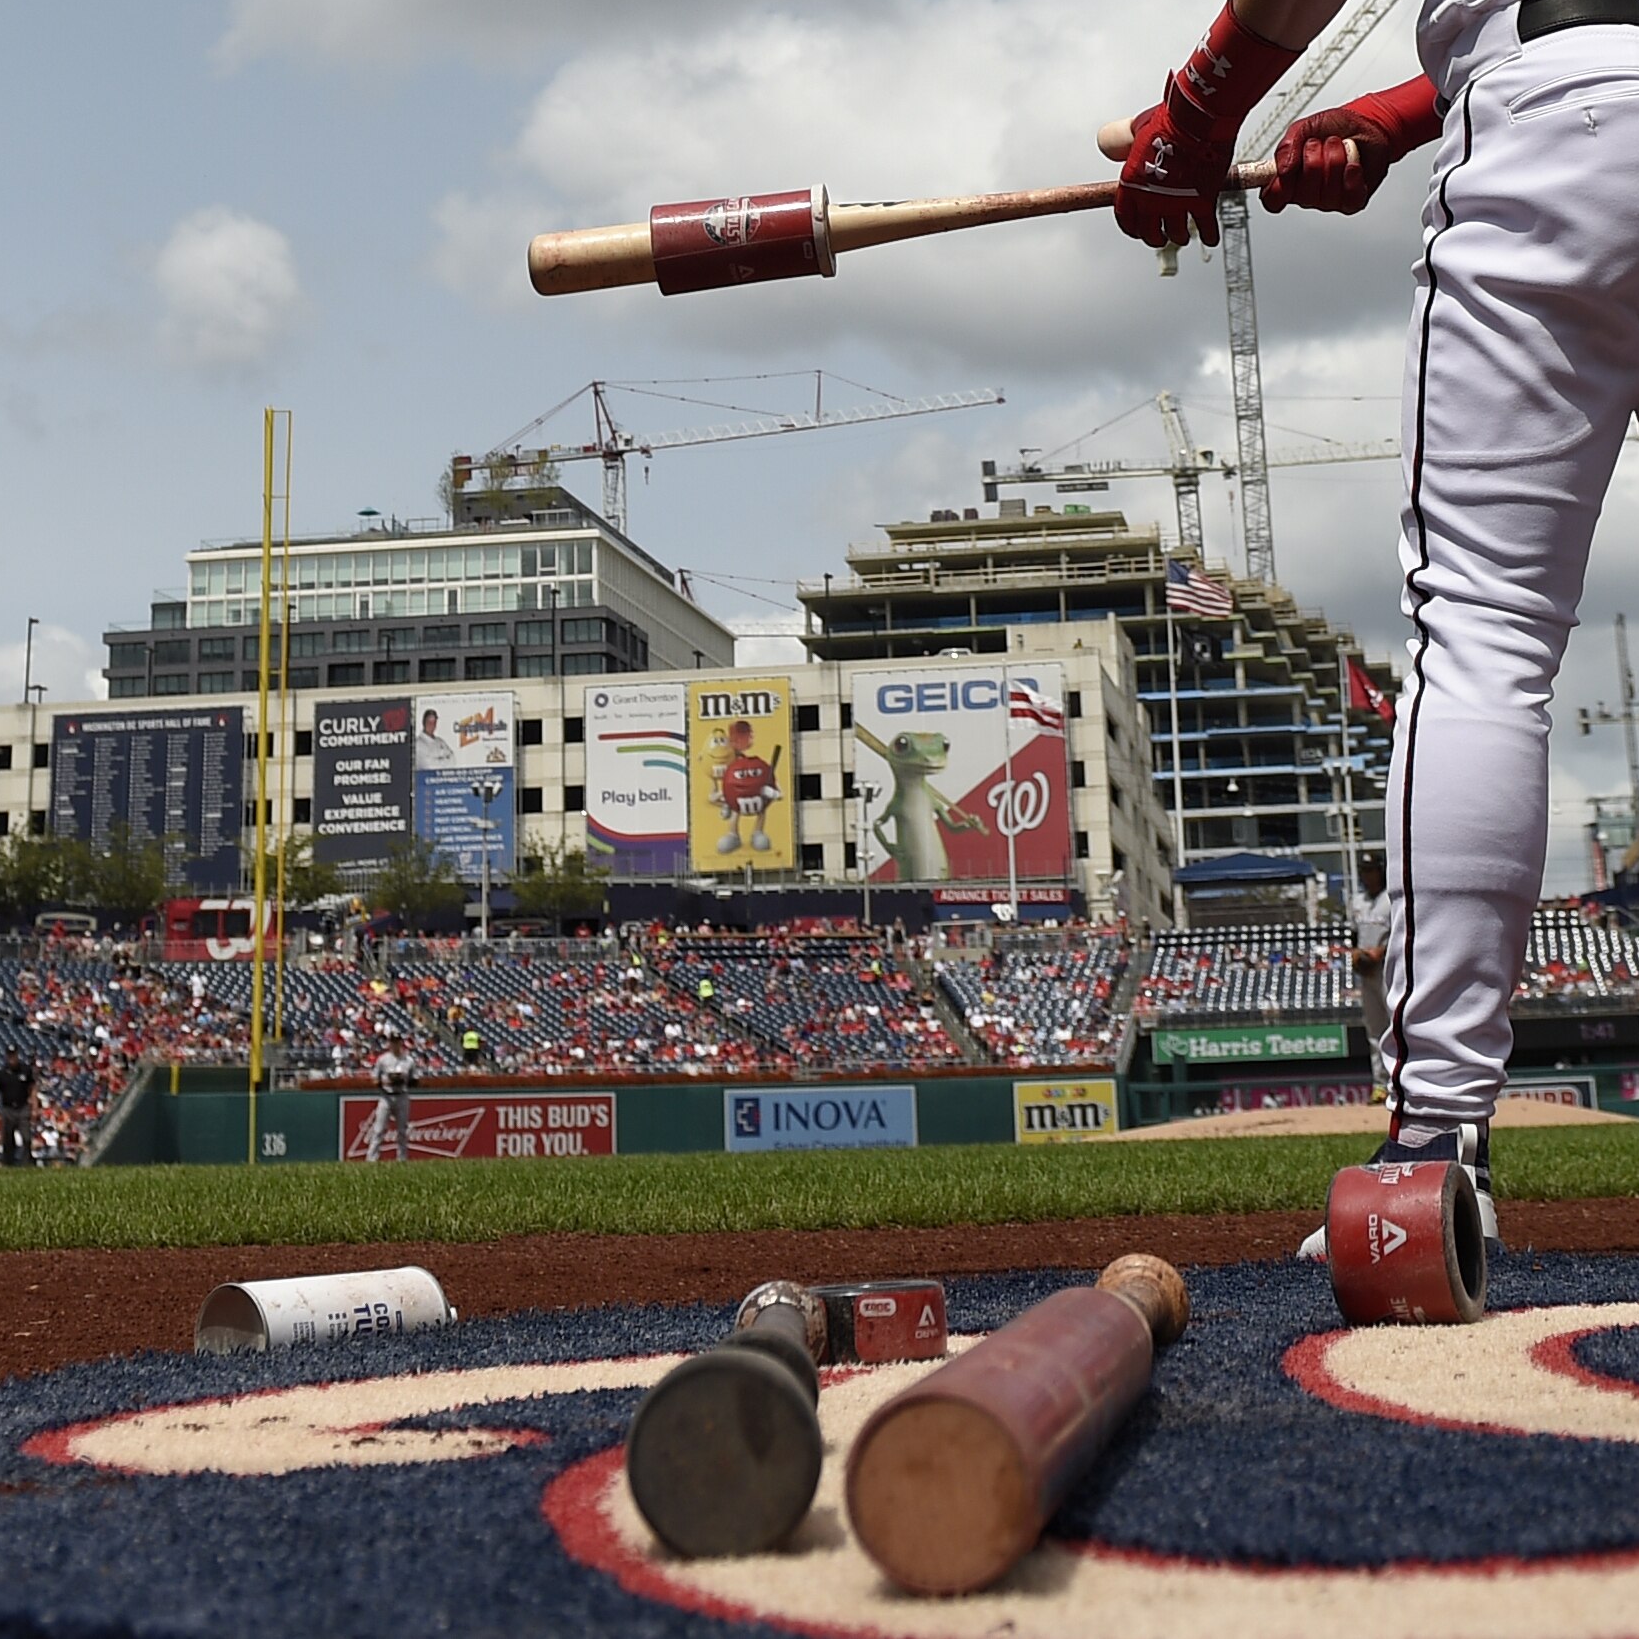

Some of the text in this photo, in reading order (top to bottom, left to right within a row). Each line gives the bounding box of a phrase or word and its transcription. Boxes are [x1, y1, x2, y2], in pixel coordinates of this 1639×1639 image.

[613, 692, 678, 706] Grant Thornton
[138, 718, 164, 730] SPORTS
[183, 716, 192, 728] OF
[319, 715, 381, 736] CURLY
[319, 731, 408, 748] COMMITMENT
[335, 757, 391, 772] OUR FAN
[333, 772, 392, 787] PROMISE:
[342, 792, 383, 805] VALUE
[601, 788, 672, 807] Play ball.
[323, 805, 401, 821] EXPERIENCE
[318, 819, 407, 835] CONVENIENCE
[940, 891, 990, 902] ADVANCE
[1030, 890, 1065, 901] SALES
[1188, 1033, 1341, 1059] Harris Teeter
[495, 1104, 610, 1129] THIS BUD'S
[772, 1100, 886, 1132] INOVA
[362, 1120, 471, 1143] uweiser
[263, 1133, 287, 1157] 336
[495, 1132, 590, 1157] FOR YOU.
[1368, 1214, 1381, 1264] VARO
